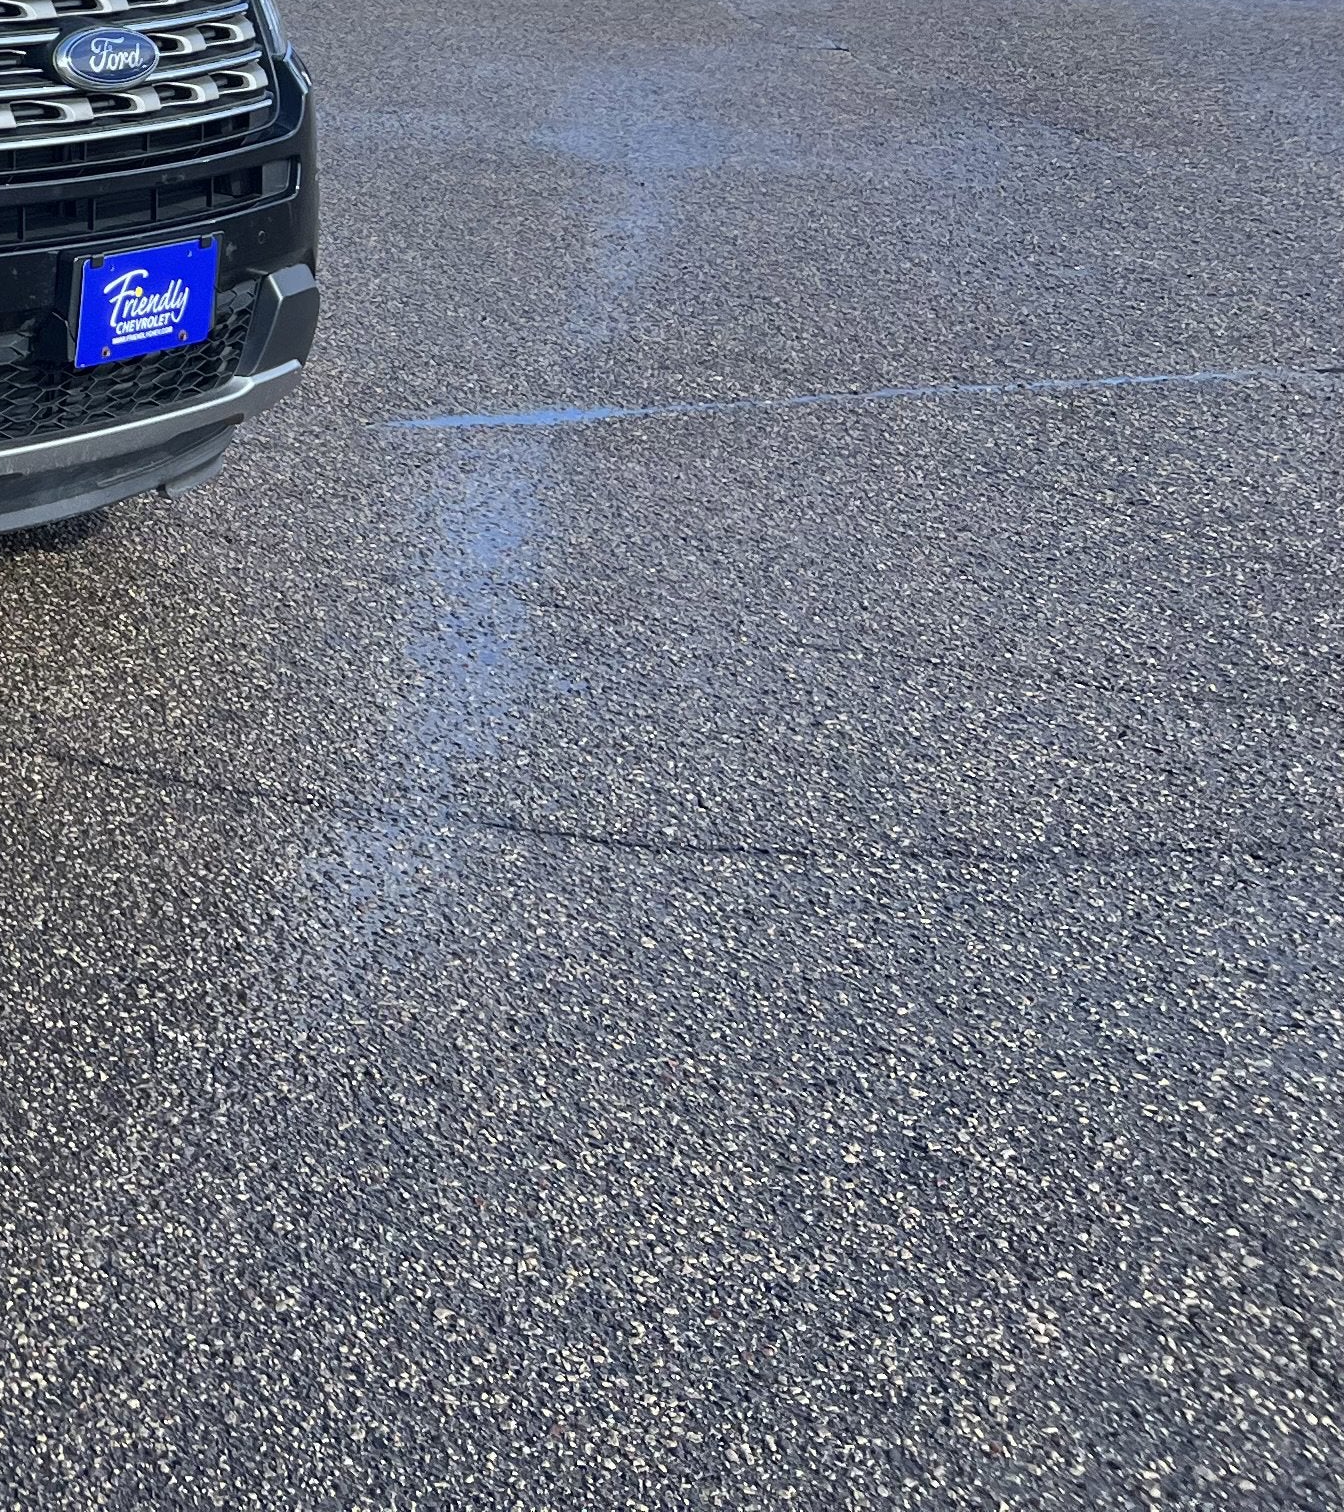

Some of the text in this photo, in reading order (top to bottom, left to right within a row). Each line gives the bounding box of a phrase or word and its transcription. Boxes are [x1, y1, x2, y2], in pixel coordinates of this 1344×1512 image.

[89, 36, 143, 72] Ford
[103, 269, 189, 328] Friendly
[115, 312, 171, 335] CHEVROLET
